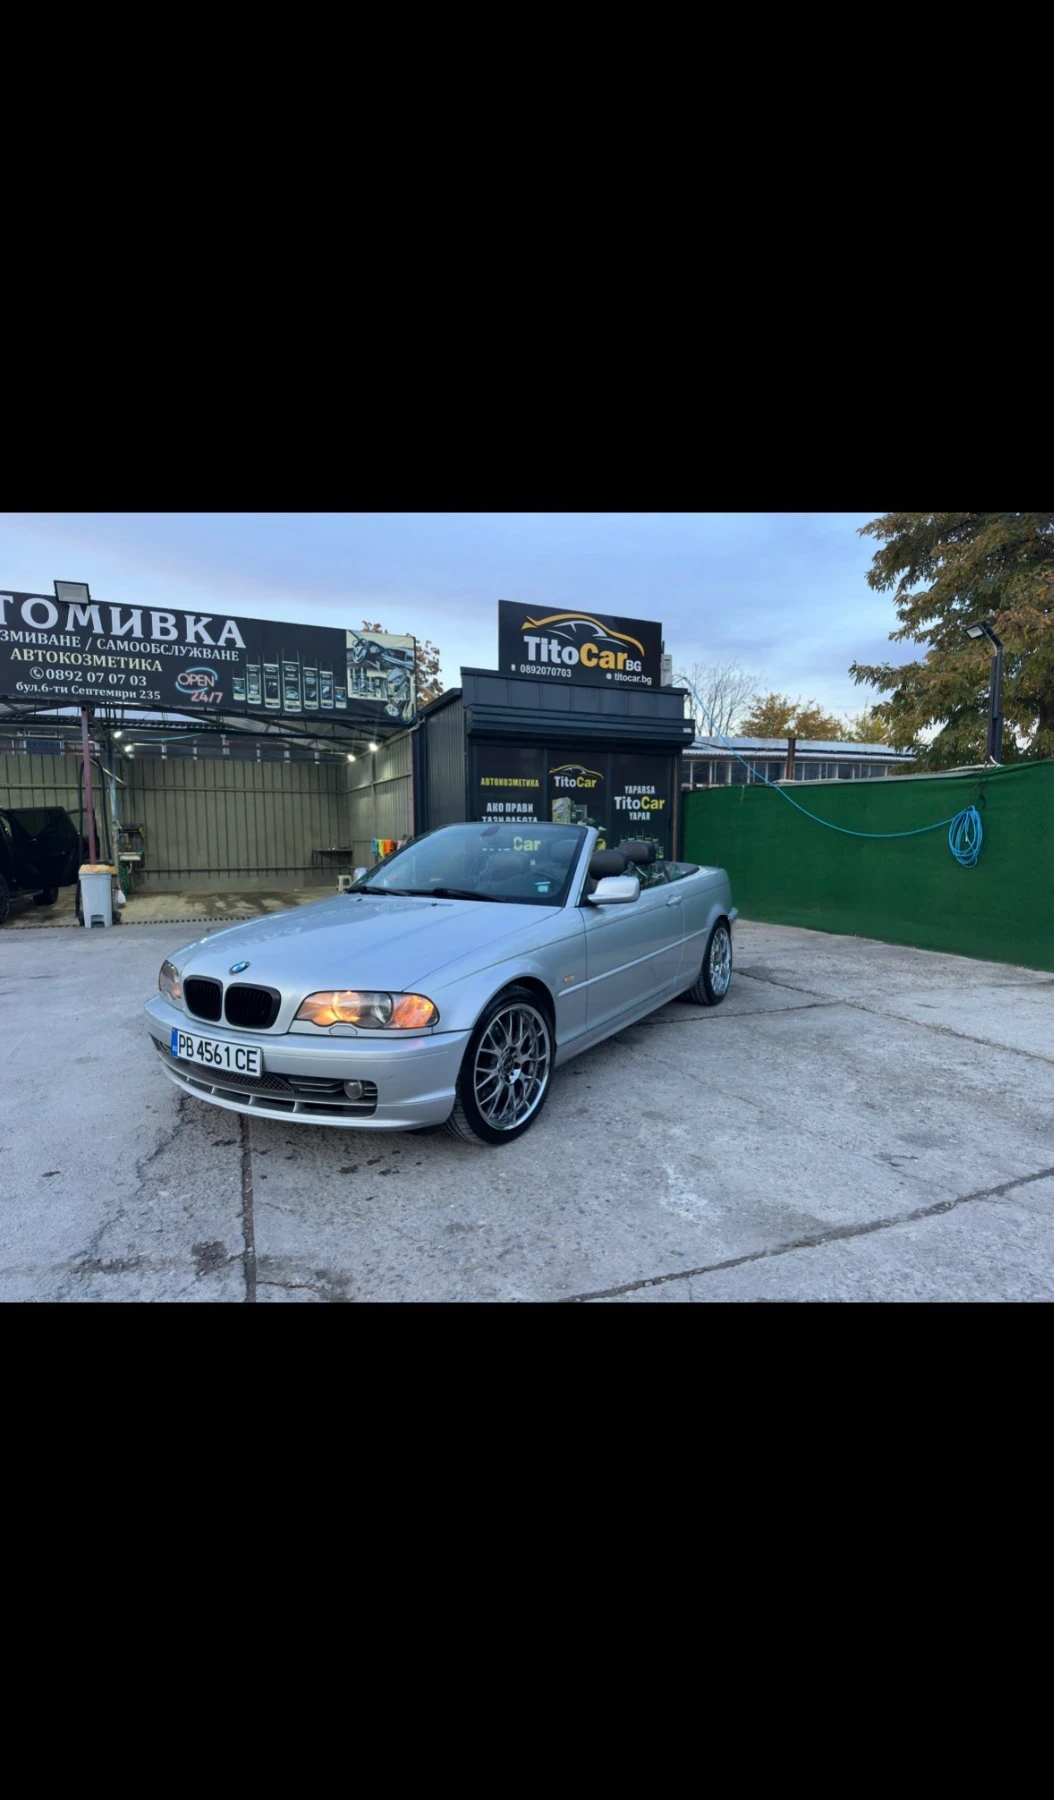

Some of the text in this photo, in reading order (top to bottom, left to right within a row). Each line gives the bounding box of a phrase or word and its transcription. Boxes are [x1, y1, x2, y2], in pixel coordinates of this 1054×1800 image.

[85, 637, 92, 652] /
[97, 638, 239, 661] САМООБСЛУЖВАНЕ
[10, 647, 163, 672] АВТОКОЗМЕТИКА
[45, 668, 147, 687] 0892 07 07 03
[520, 663, 572, 678] 0892070703
[177, 672, 215, 687] OPEN
[614, 673, 652, 686] titocar.bg
[71, 685, 137, 699] Септември
[137, 689, 161, 700] 235
[191, 690, 223, 703] 24/7
[481, 777, 540, 788] АВТОКОЗМЕТИКА
[554, 776, 597, 788] TitoCar
[624, 785, 656, 795] YAPARSA
[486, 802, 534, 813] АКО ПРАВИ
[614, 796, 665, 810] TitoCar
[629, 812, 651, 821] YAPAR
[196, 1040, 230, 1067] 4561
